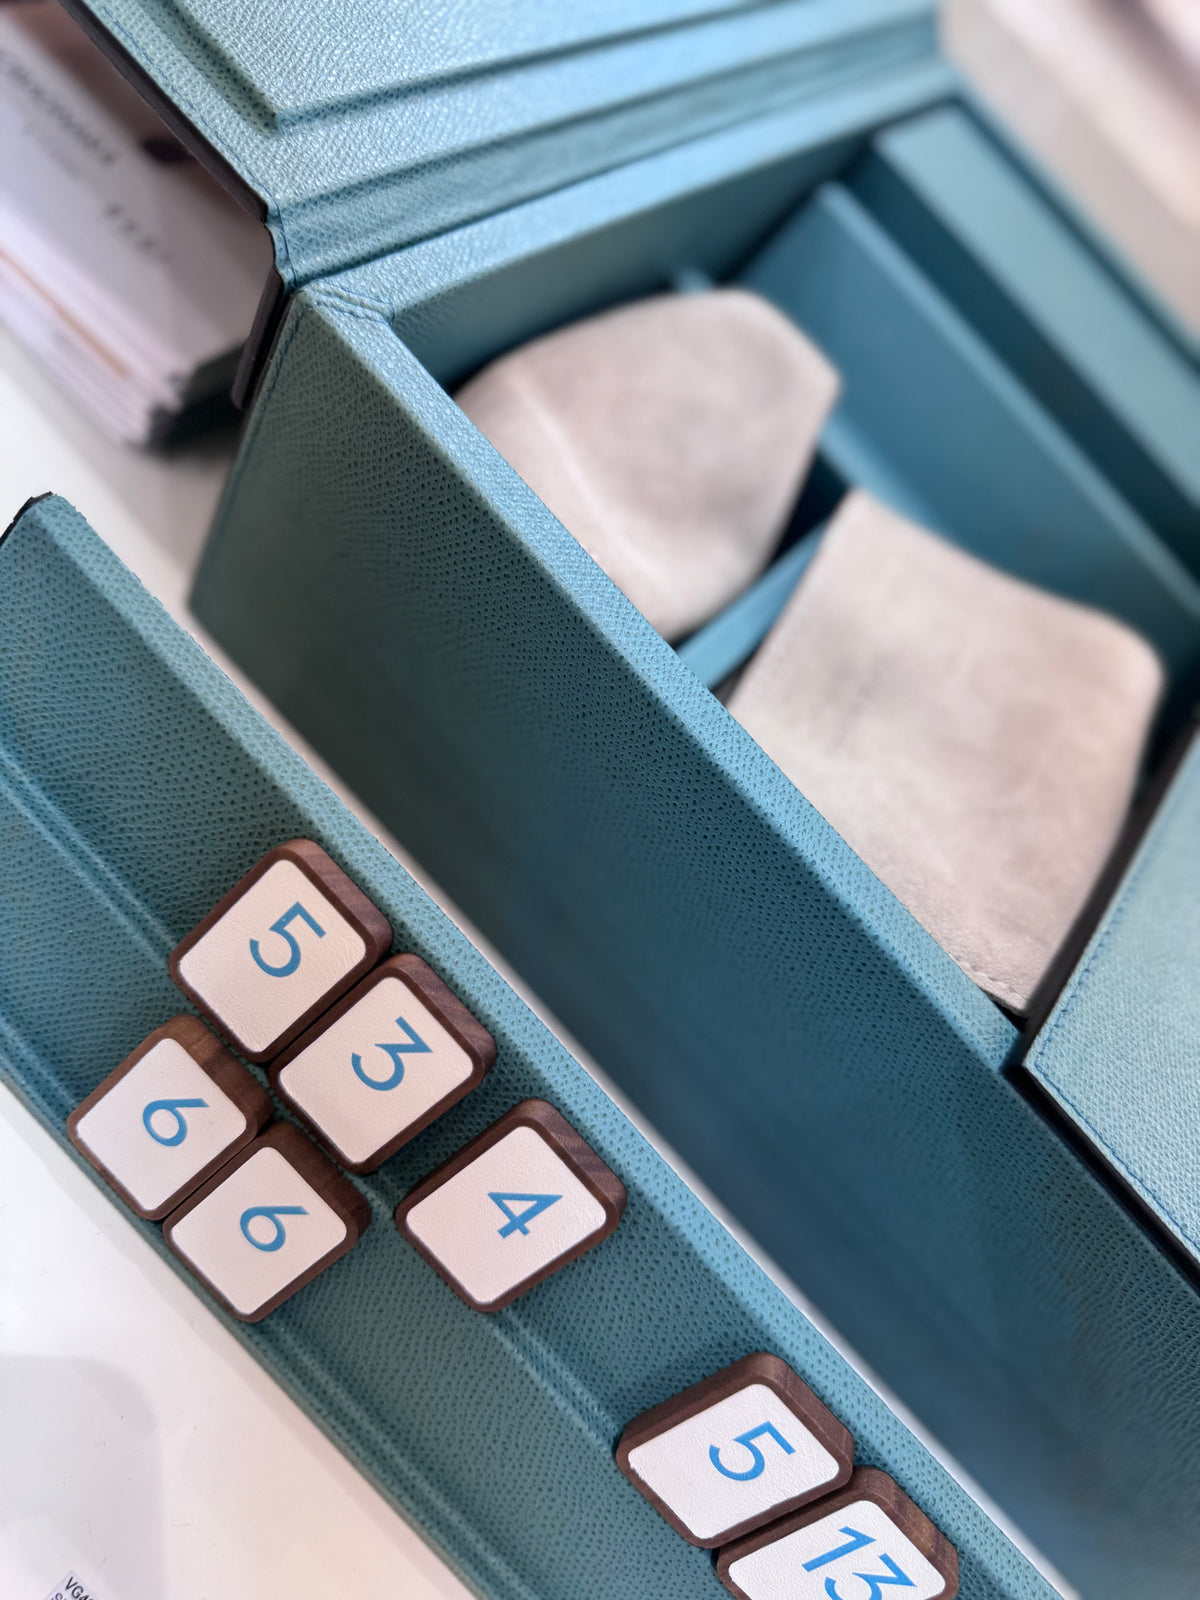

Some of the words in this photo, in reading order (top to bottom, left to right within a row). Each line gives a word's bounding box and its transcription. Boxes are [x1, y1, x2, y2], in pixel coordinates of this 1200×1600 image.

[249, 902, 325, 978] 5
[351, 1016, 432, 1091] 3
[142, 1098, 209, 1147] 6
[239, 1205, 309, 1253] 6
[487, 1191, 563, 1239] 4
[708, 1420, 796, 1482] 5
[801, 1525, 917, 1600] 13
